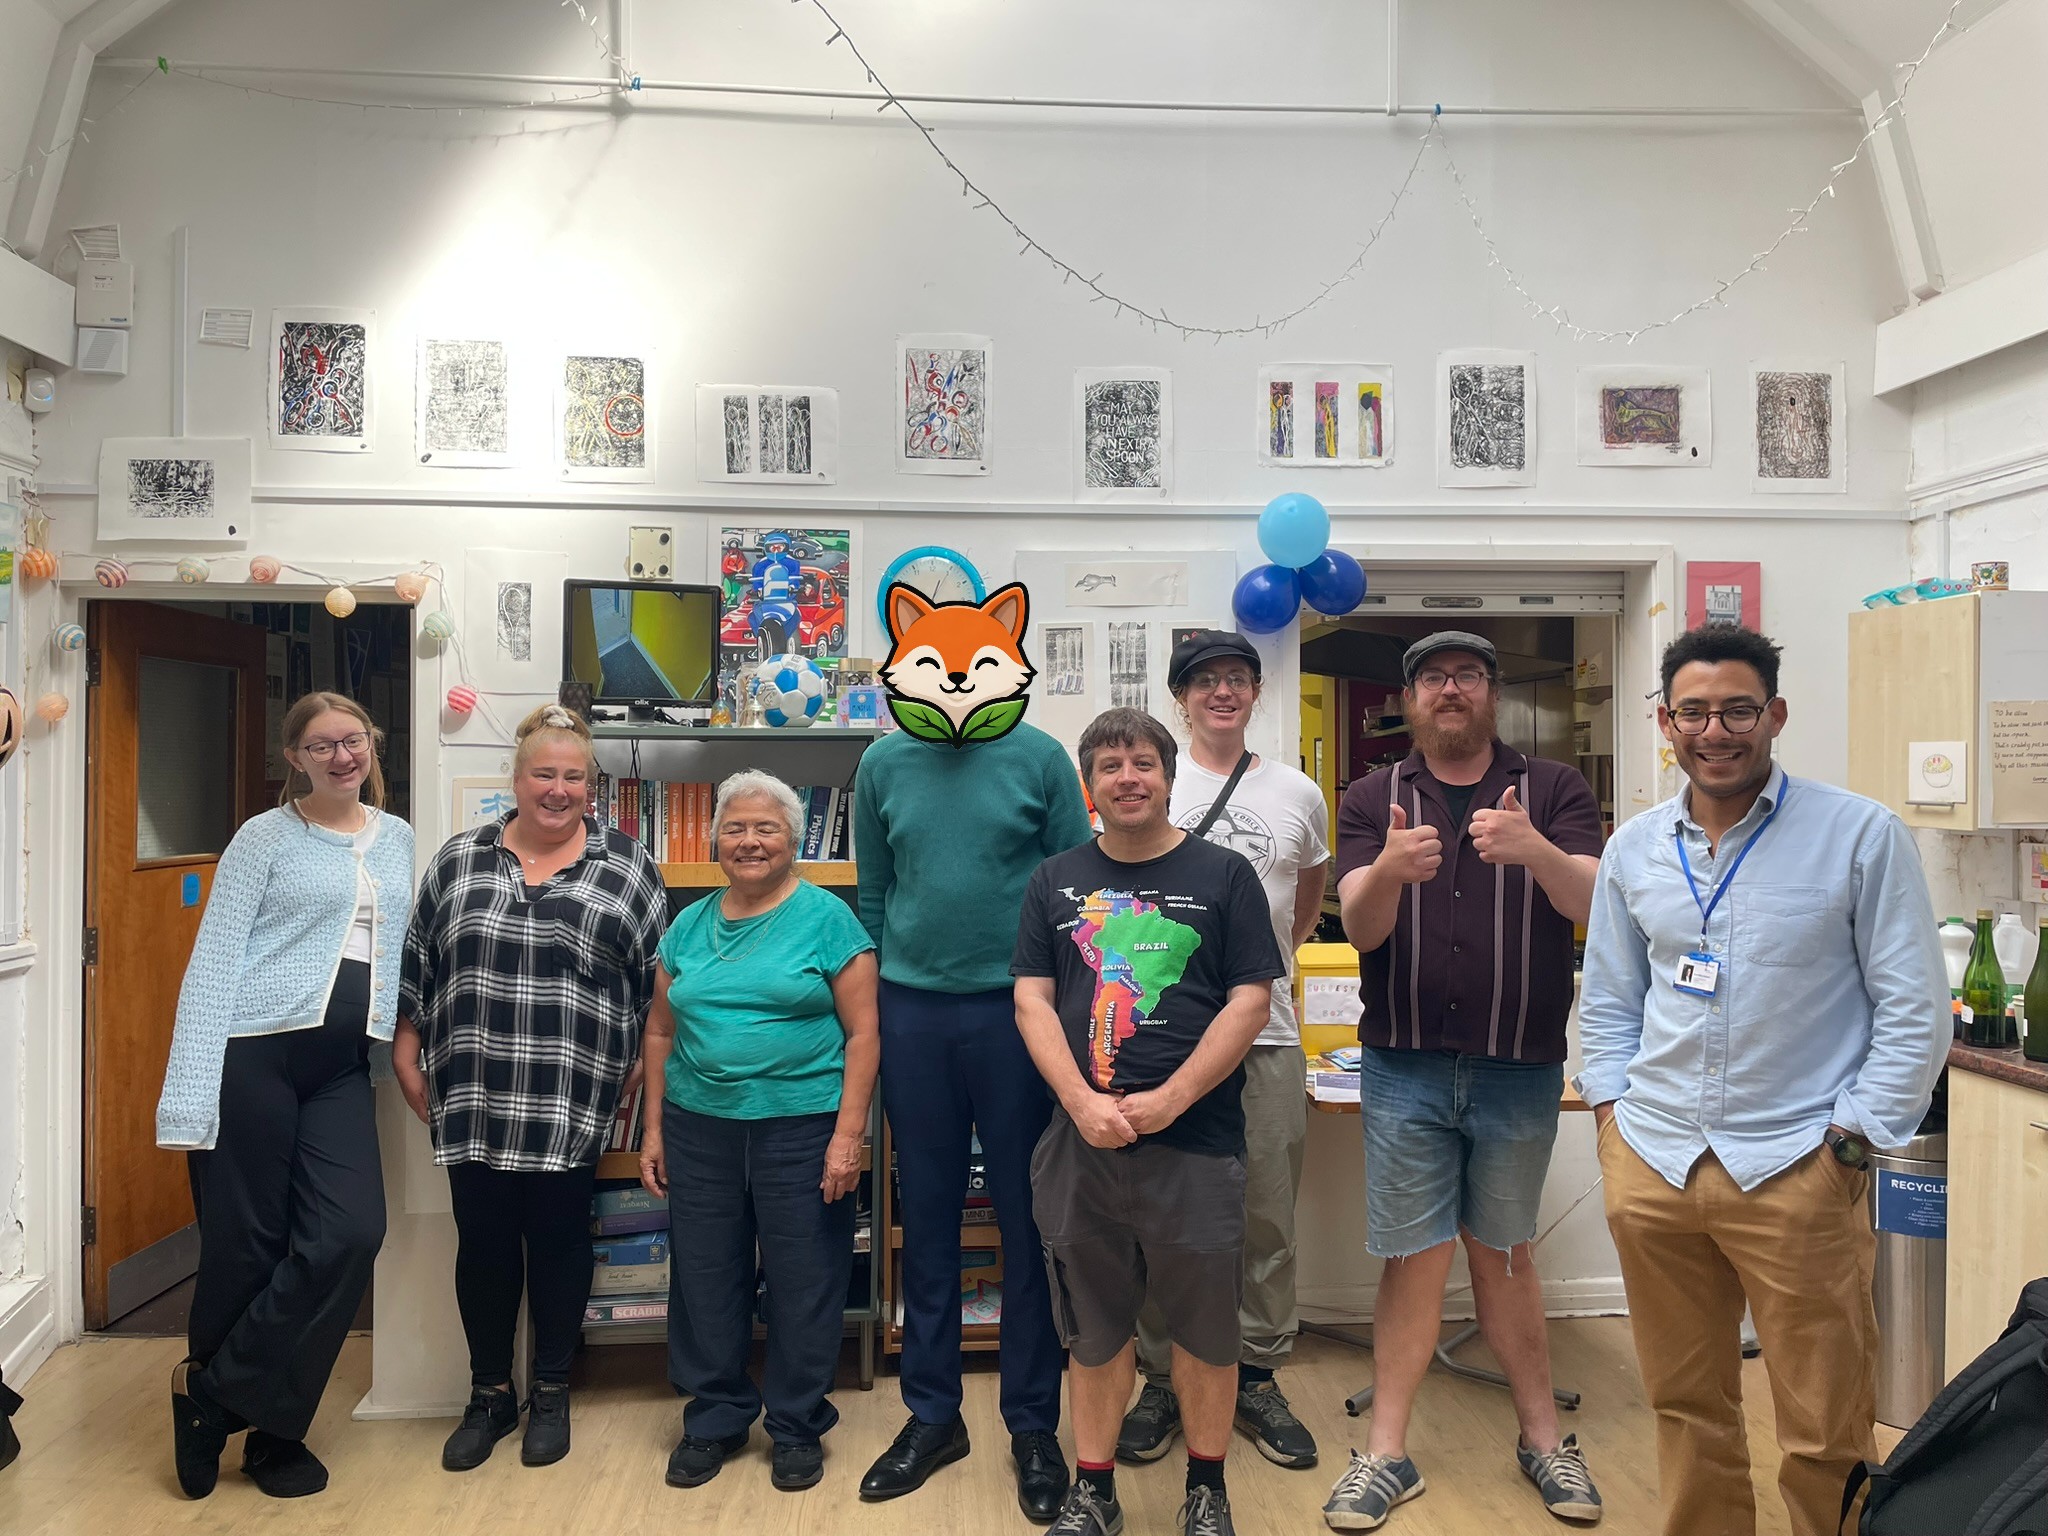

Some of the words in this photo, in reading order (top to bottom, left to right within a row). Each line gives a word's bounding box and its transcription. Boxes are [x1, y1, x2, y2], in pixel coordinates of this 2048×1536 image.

[1110, 402, 1134, 414] MAY
[1092, 414, 1116, 426] YOU
[1119, 414, 1159, 427] ALWAYS
[1106, 426, 1136, 438] HAVE
[1100, 438, 1116, 450] AN
[1118, 438, 1155, 450] EXTRA
[1106, 450, 1145, 462] SPOON
[838, 793, 847, 813] TAYLOR
[834, 816, 843, 835] DREAM
[1233, 813, 1260, 830] FORCE
[807, 814, 823, 855] Physics
[831, 836, 840, 853] WORK
[1082, 942, 1096, 962] PERU
[1133, 942, 1168, 951] BRAZIL
[1103, 1001, 1115, 1055] ARGENTINA
[1891, 1179, 1948, 1193] RECYCLI
